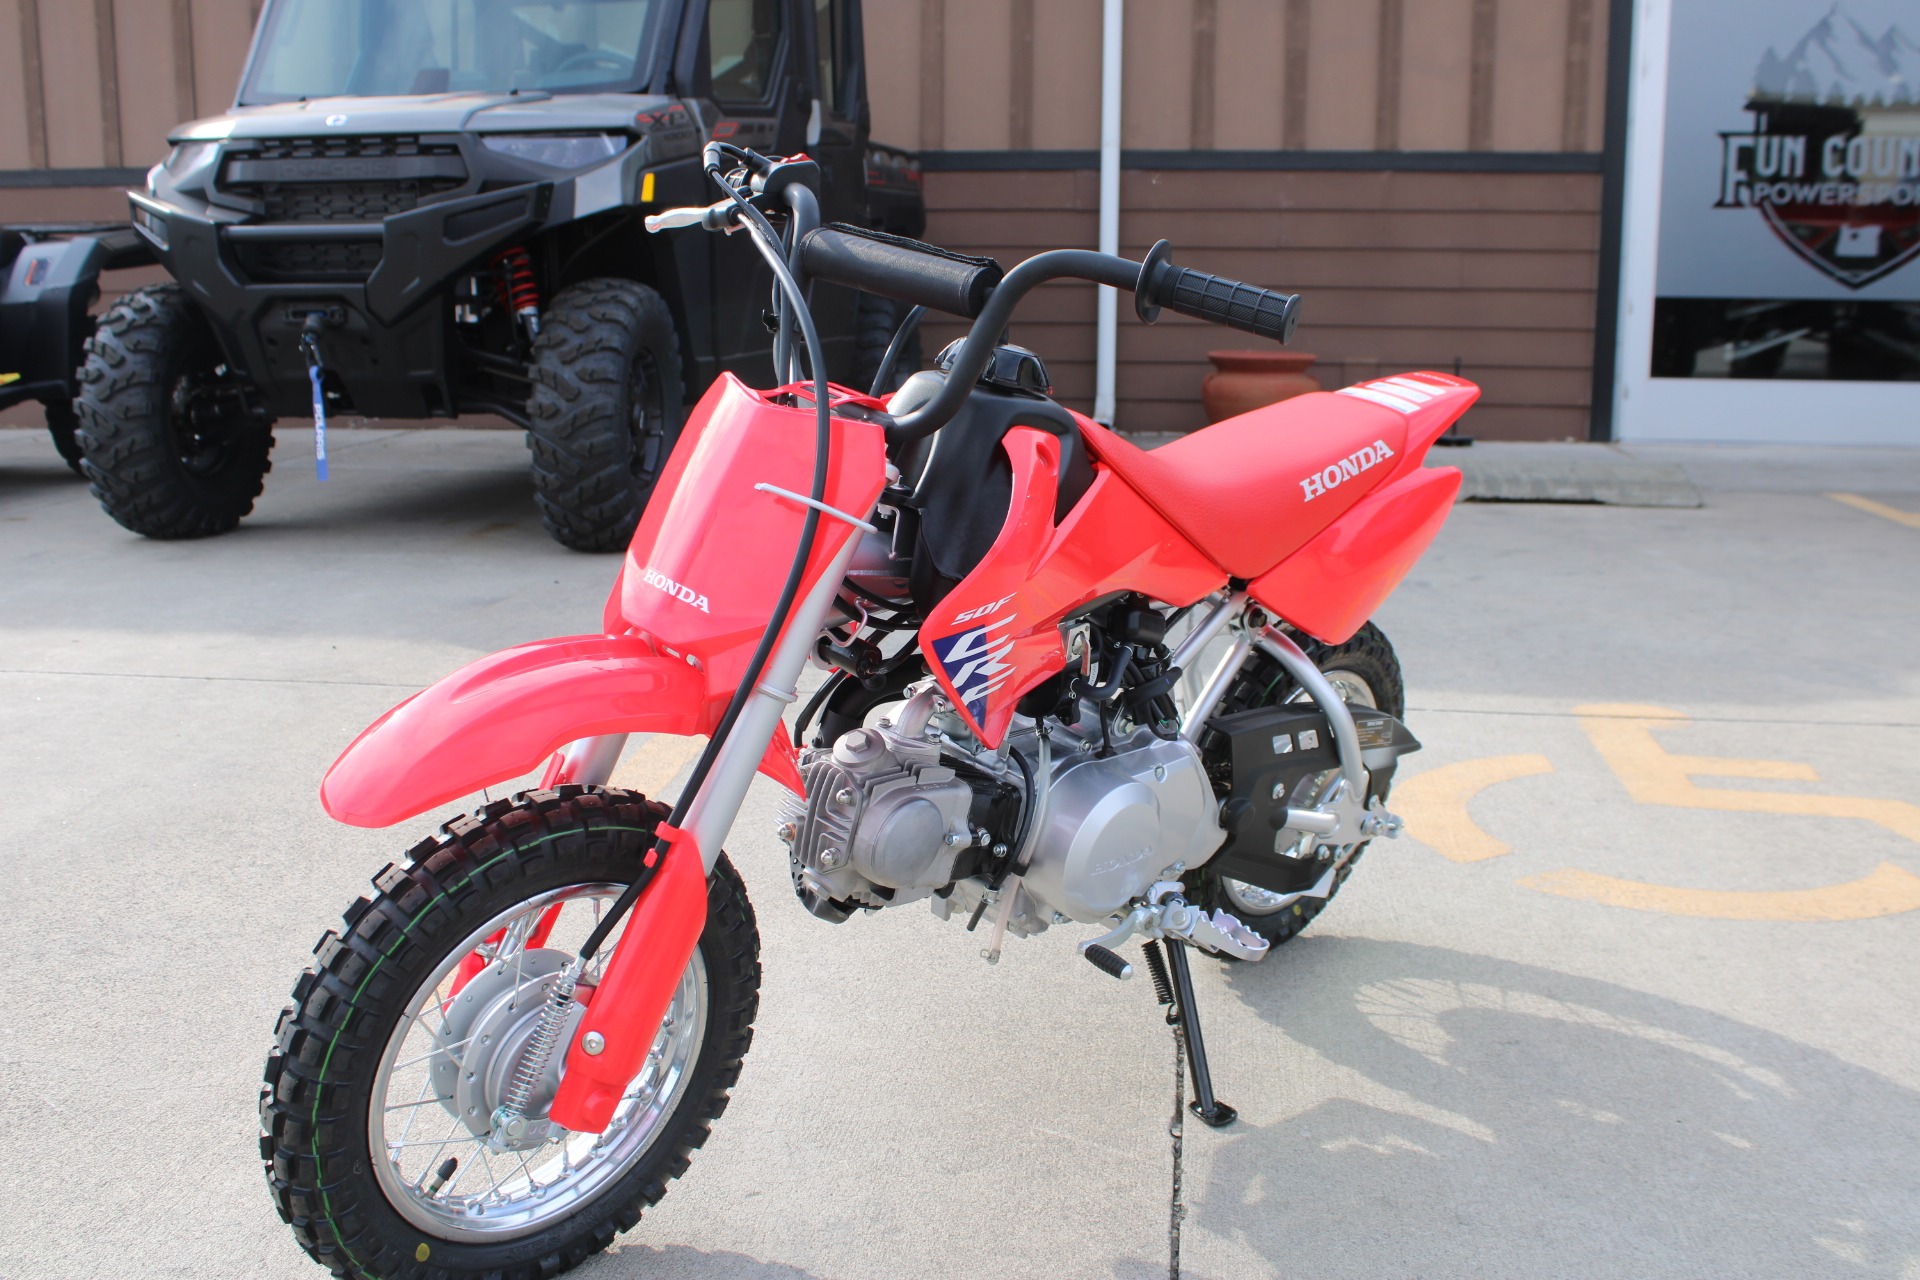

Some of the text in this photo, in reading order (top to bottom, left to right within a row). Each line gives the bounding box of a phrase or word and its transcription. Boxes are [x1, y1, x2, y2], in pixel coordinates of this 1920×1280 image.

[1714, 133, 1807, 207] FUN
[1299, 439, 1395, 502] HONDA
[643, 567, 710, 614] HONDA
[943, 613, 1018, 706] CRF
